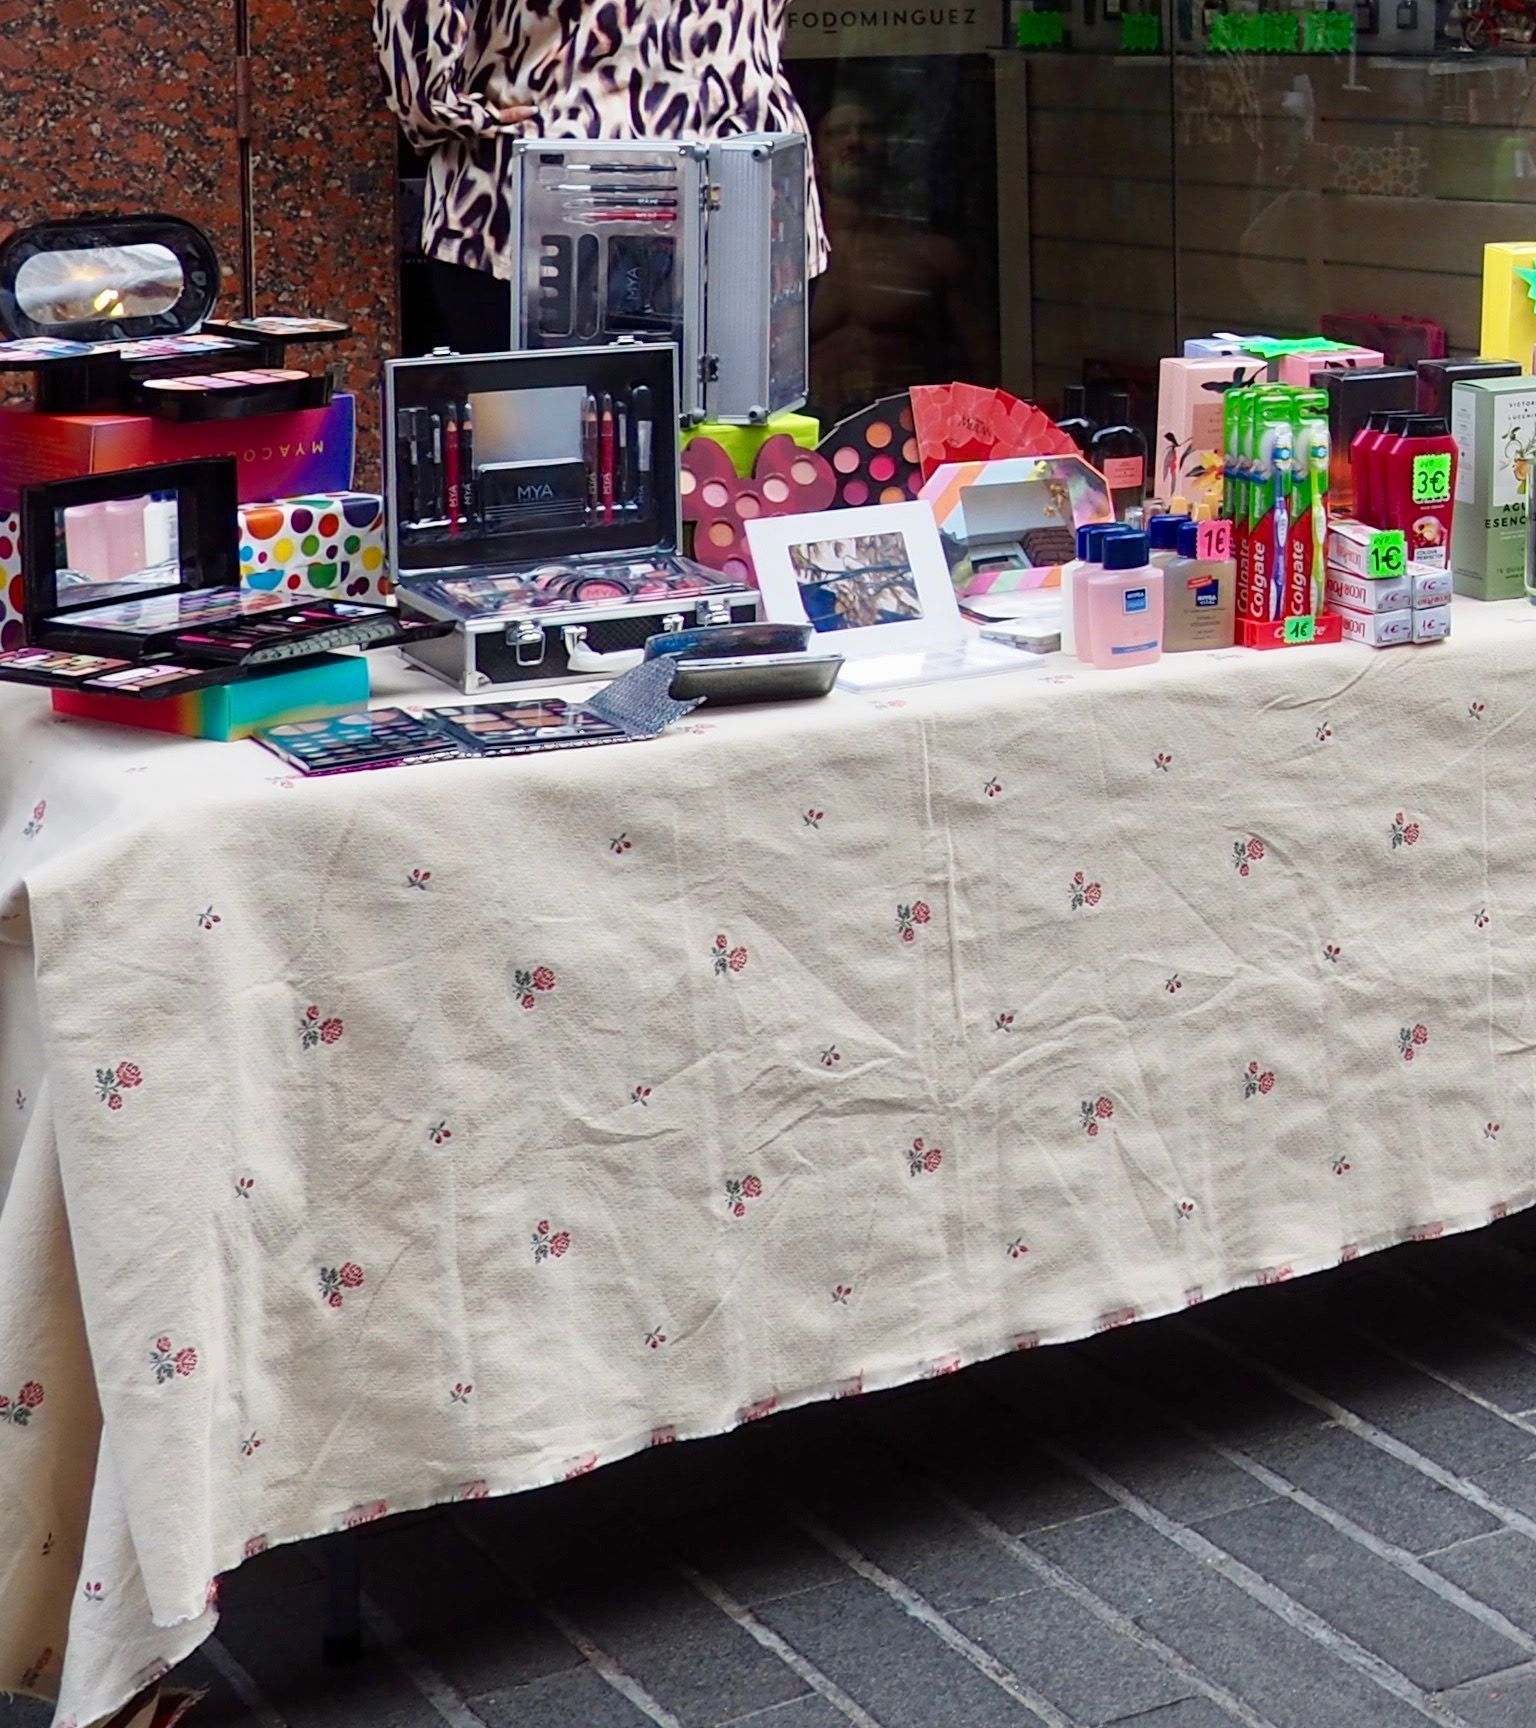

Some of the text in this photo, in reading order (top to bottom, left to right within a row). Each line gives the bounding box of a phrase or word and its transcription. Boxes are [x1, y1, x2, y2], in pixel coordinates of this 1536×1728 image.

[517, 483, 554, 500] MYA
[603, 472, 611, 495] MYA
[1417, 470, 1446, 495] 3€
[450, 483, 458, 508] MYA
[1204, 527, 1226, 557] 1€
[1371, 545, 1402, 572] 1€
[1250, 542, 1266, 618] Colgate
[1291, 540, 1305, 616] Colgate
[1343, 585, 1366, 604] LICOR
[1290, 622, 1309, 638] 1€
